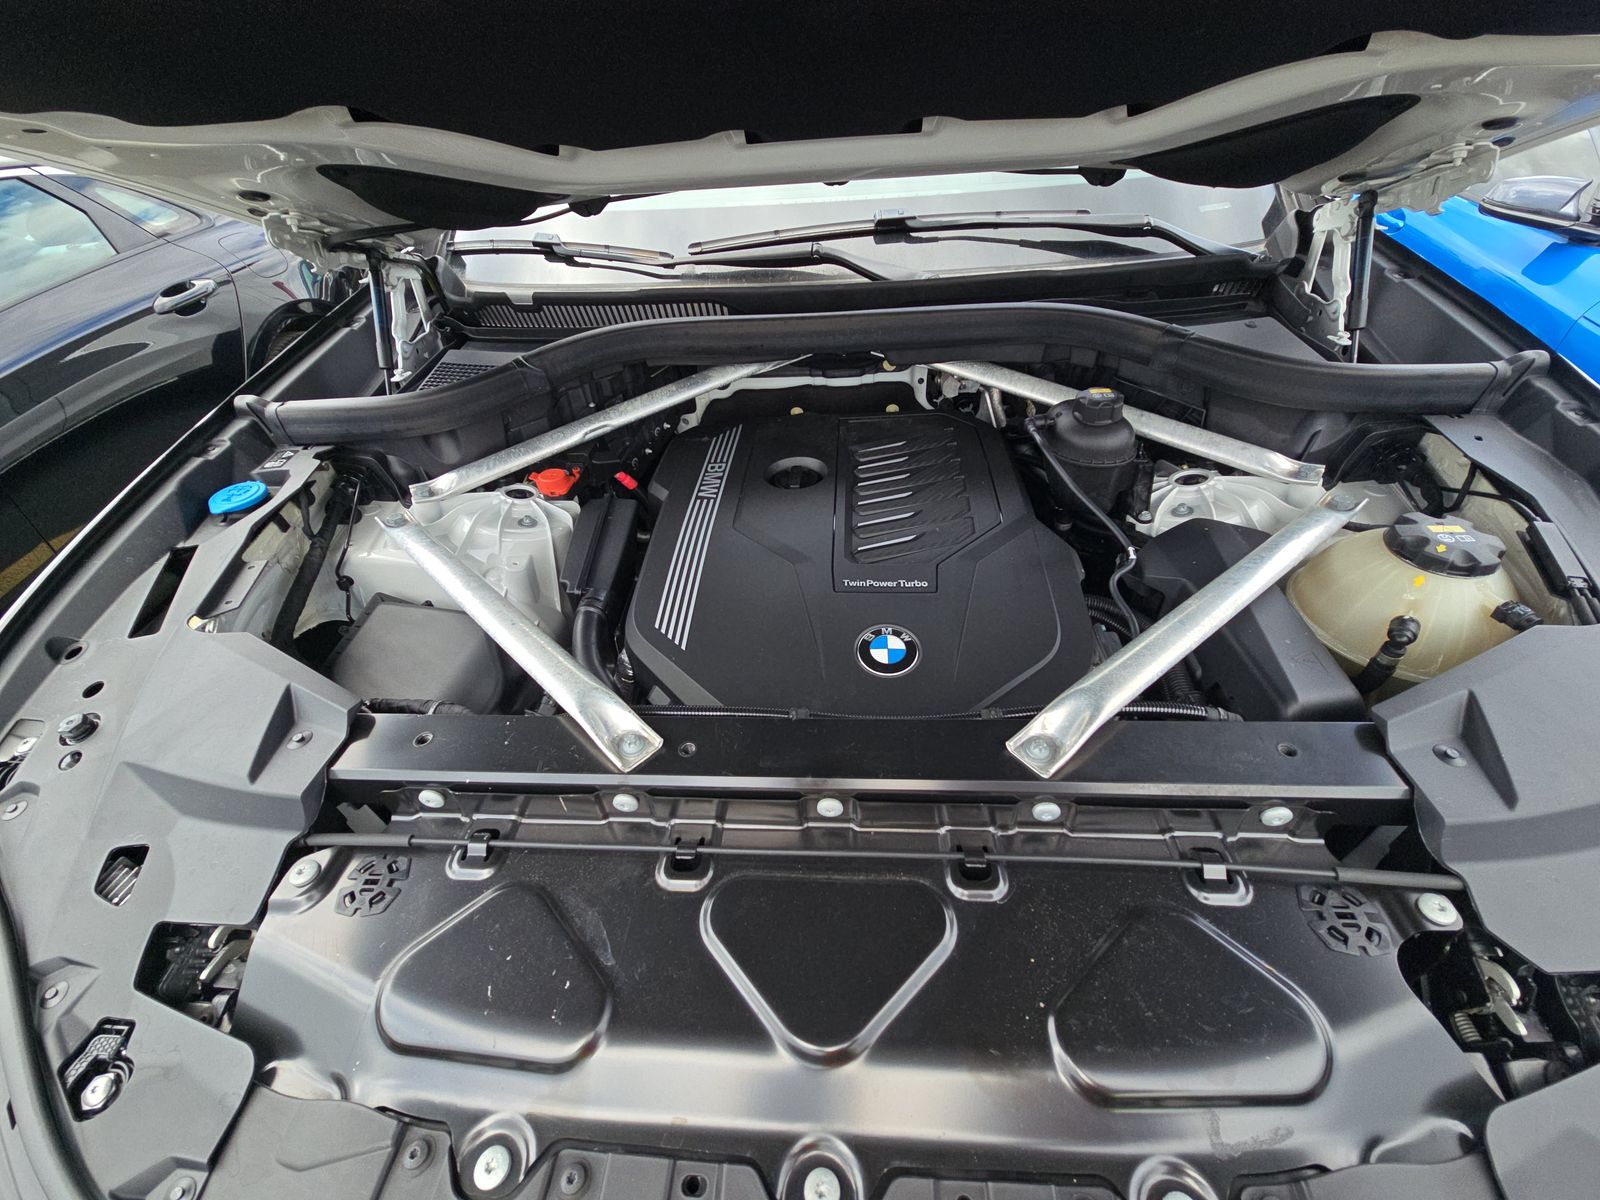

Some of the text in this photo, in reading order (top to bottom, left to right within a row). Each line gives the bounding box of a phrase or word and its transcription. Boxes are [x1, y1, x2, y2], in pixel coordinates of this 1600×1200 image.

[697, 463, 727, 498] BMW
[898, 579, 928, 587] Turbo
[864, 627, 911, 641] BMW
